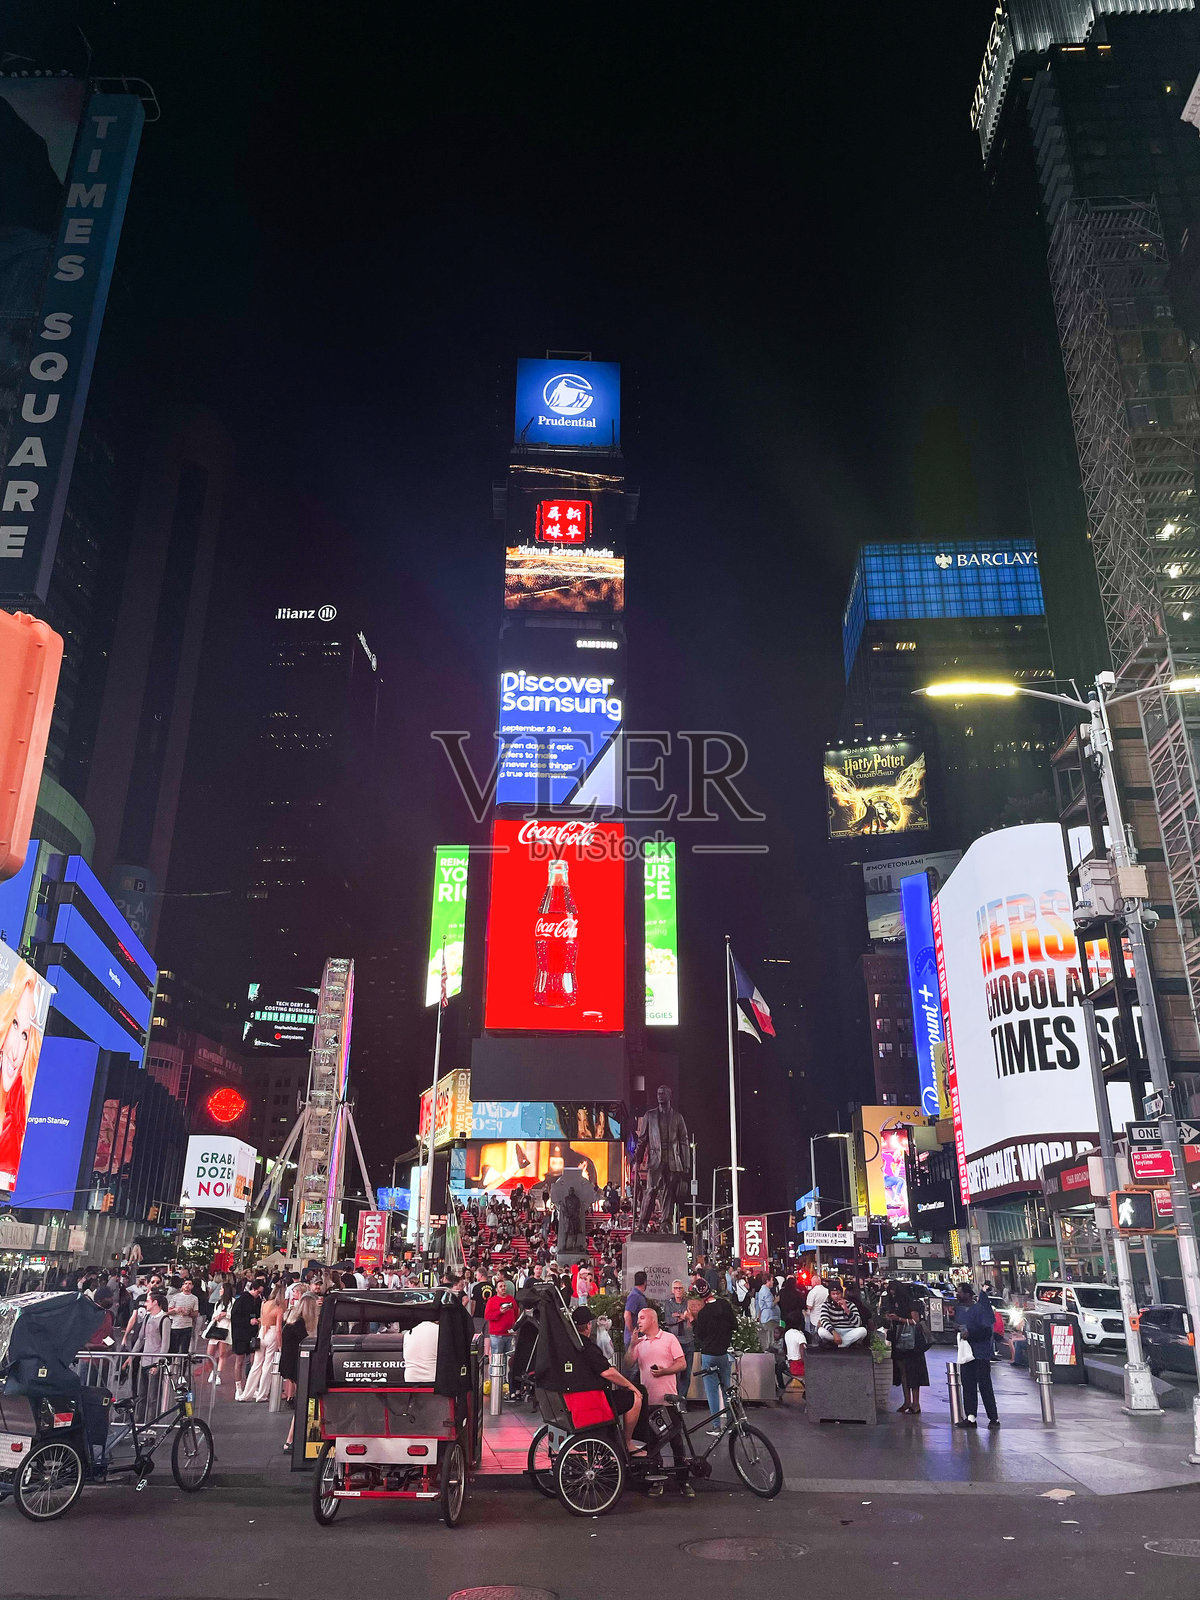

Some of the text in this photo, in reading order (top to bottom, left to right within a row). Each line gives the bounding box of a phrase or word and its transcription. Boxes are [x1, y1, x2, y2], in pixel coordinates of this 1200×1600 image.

[0, 114, 118, 559] TIMES SQUARE
[537, 415, 597, 428] Prudential
[518, 545, 614, 558] Xinhua Screen Media
[275, 607, 316, 620] llianz
[576, 639, 618, 650] SAMSUNG
[502, 670, 615, 695] Discover
[502, 691, 622, 721] Samsung
[546, 725, 556, 733] 20
[525, 742, 545, 752] days
[556, 743, 574, 752] epic
[525, 751, 534, 759] to
[535, 752, 558, 760] make
[530, 761, 547, 769] lose
[842, 753, 906, 776] Harry Potter
[865, 859, 924, 872] #MOVETOMIAMI
[936, 951, 949, 1001] STORE
[990, 1014, 1081, 1080] TIMES
[455, 1072, 467, 1133] WE MISSED
[47, 1116, 70, 1126] Stanley
[1138, 1129, 1160, 1139] ONE
[951, 1086, 970, 1204] FREE CHOCOL
[200, 1152, 231, 1165] GRAB
[1141, 1152, 1163, 1160] STANDING
[197, 1181, 232, 1197] NOW
[363, 1214, 382, 1250] tkts
[744, 1219, 763, 1257] tkts
[643, 1266, 671, 1274] GEORGE
